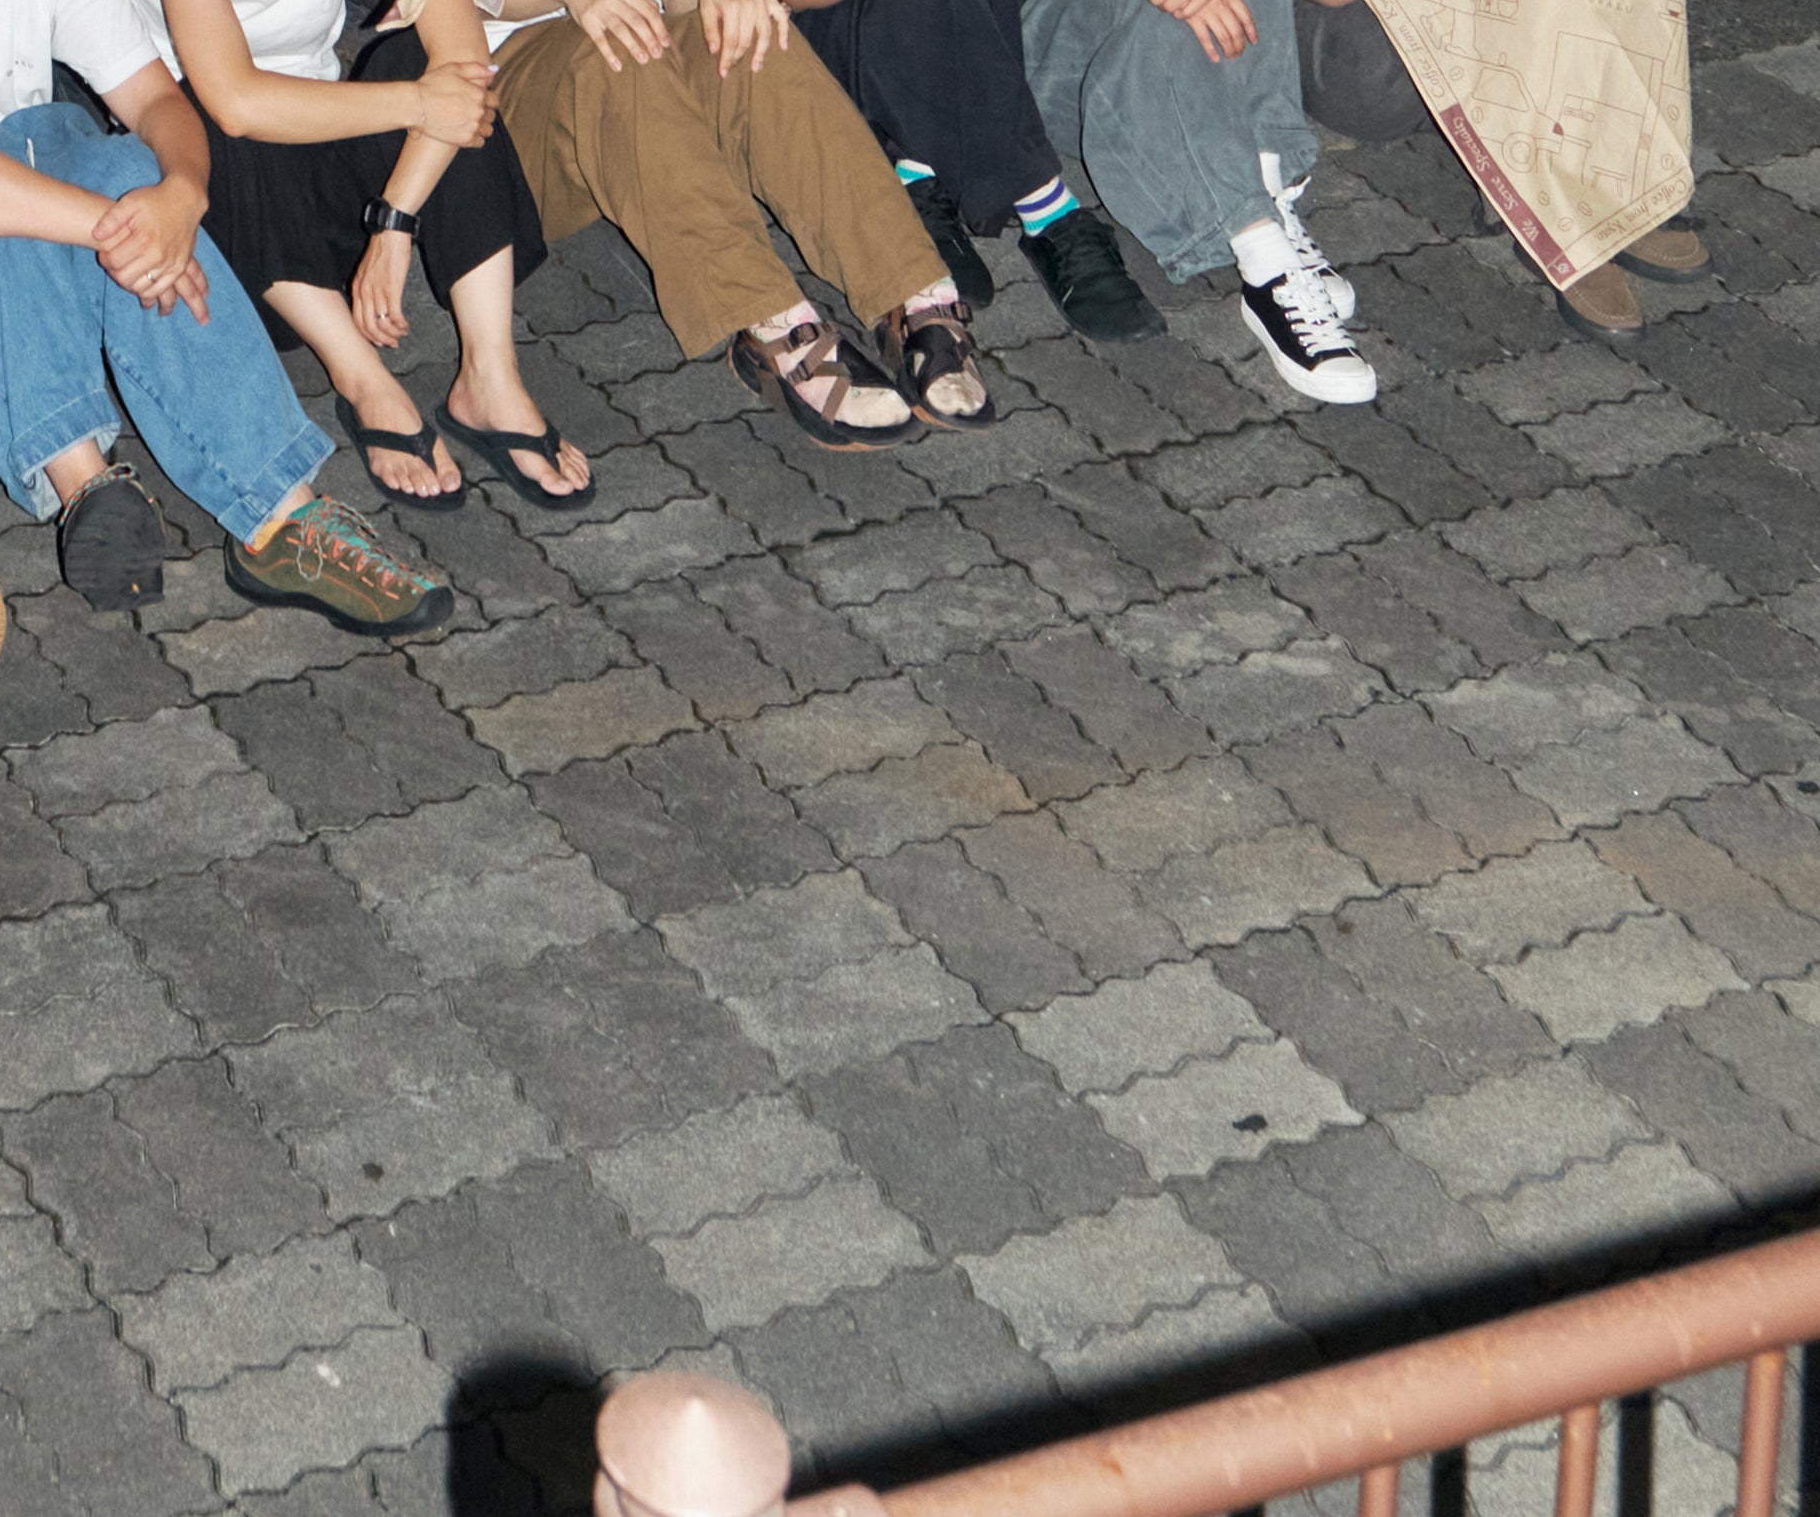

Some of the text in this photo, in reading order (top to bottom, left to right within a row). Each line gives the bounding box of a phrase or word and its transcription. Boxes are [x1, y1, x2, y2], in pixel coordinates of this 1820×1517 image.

[1398, 24, 1422, 53] from
[1420, 58, 1445, 99] Coffee
[1453, 117, 1491, 173] Specialty
[1491, 175, 1519, 211] Serve
[1651, 178, 1688, 206] Coffee
[1624, 200, 1651, 224] from
[1521, 219, 1540, 242] We
